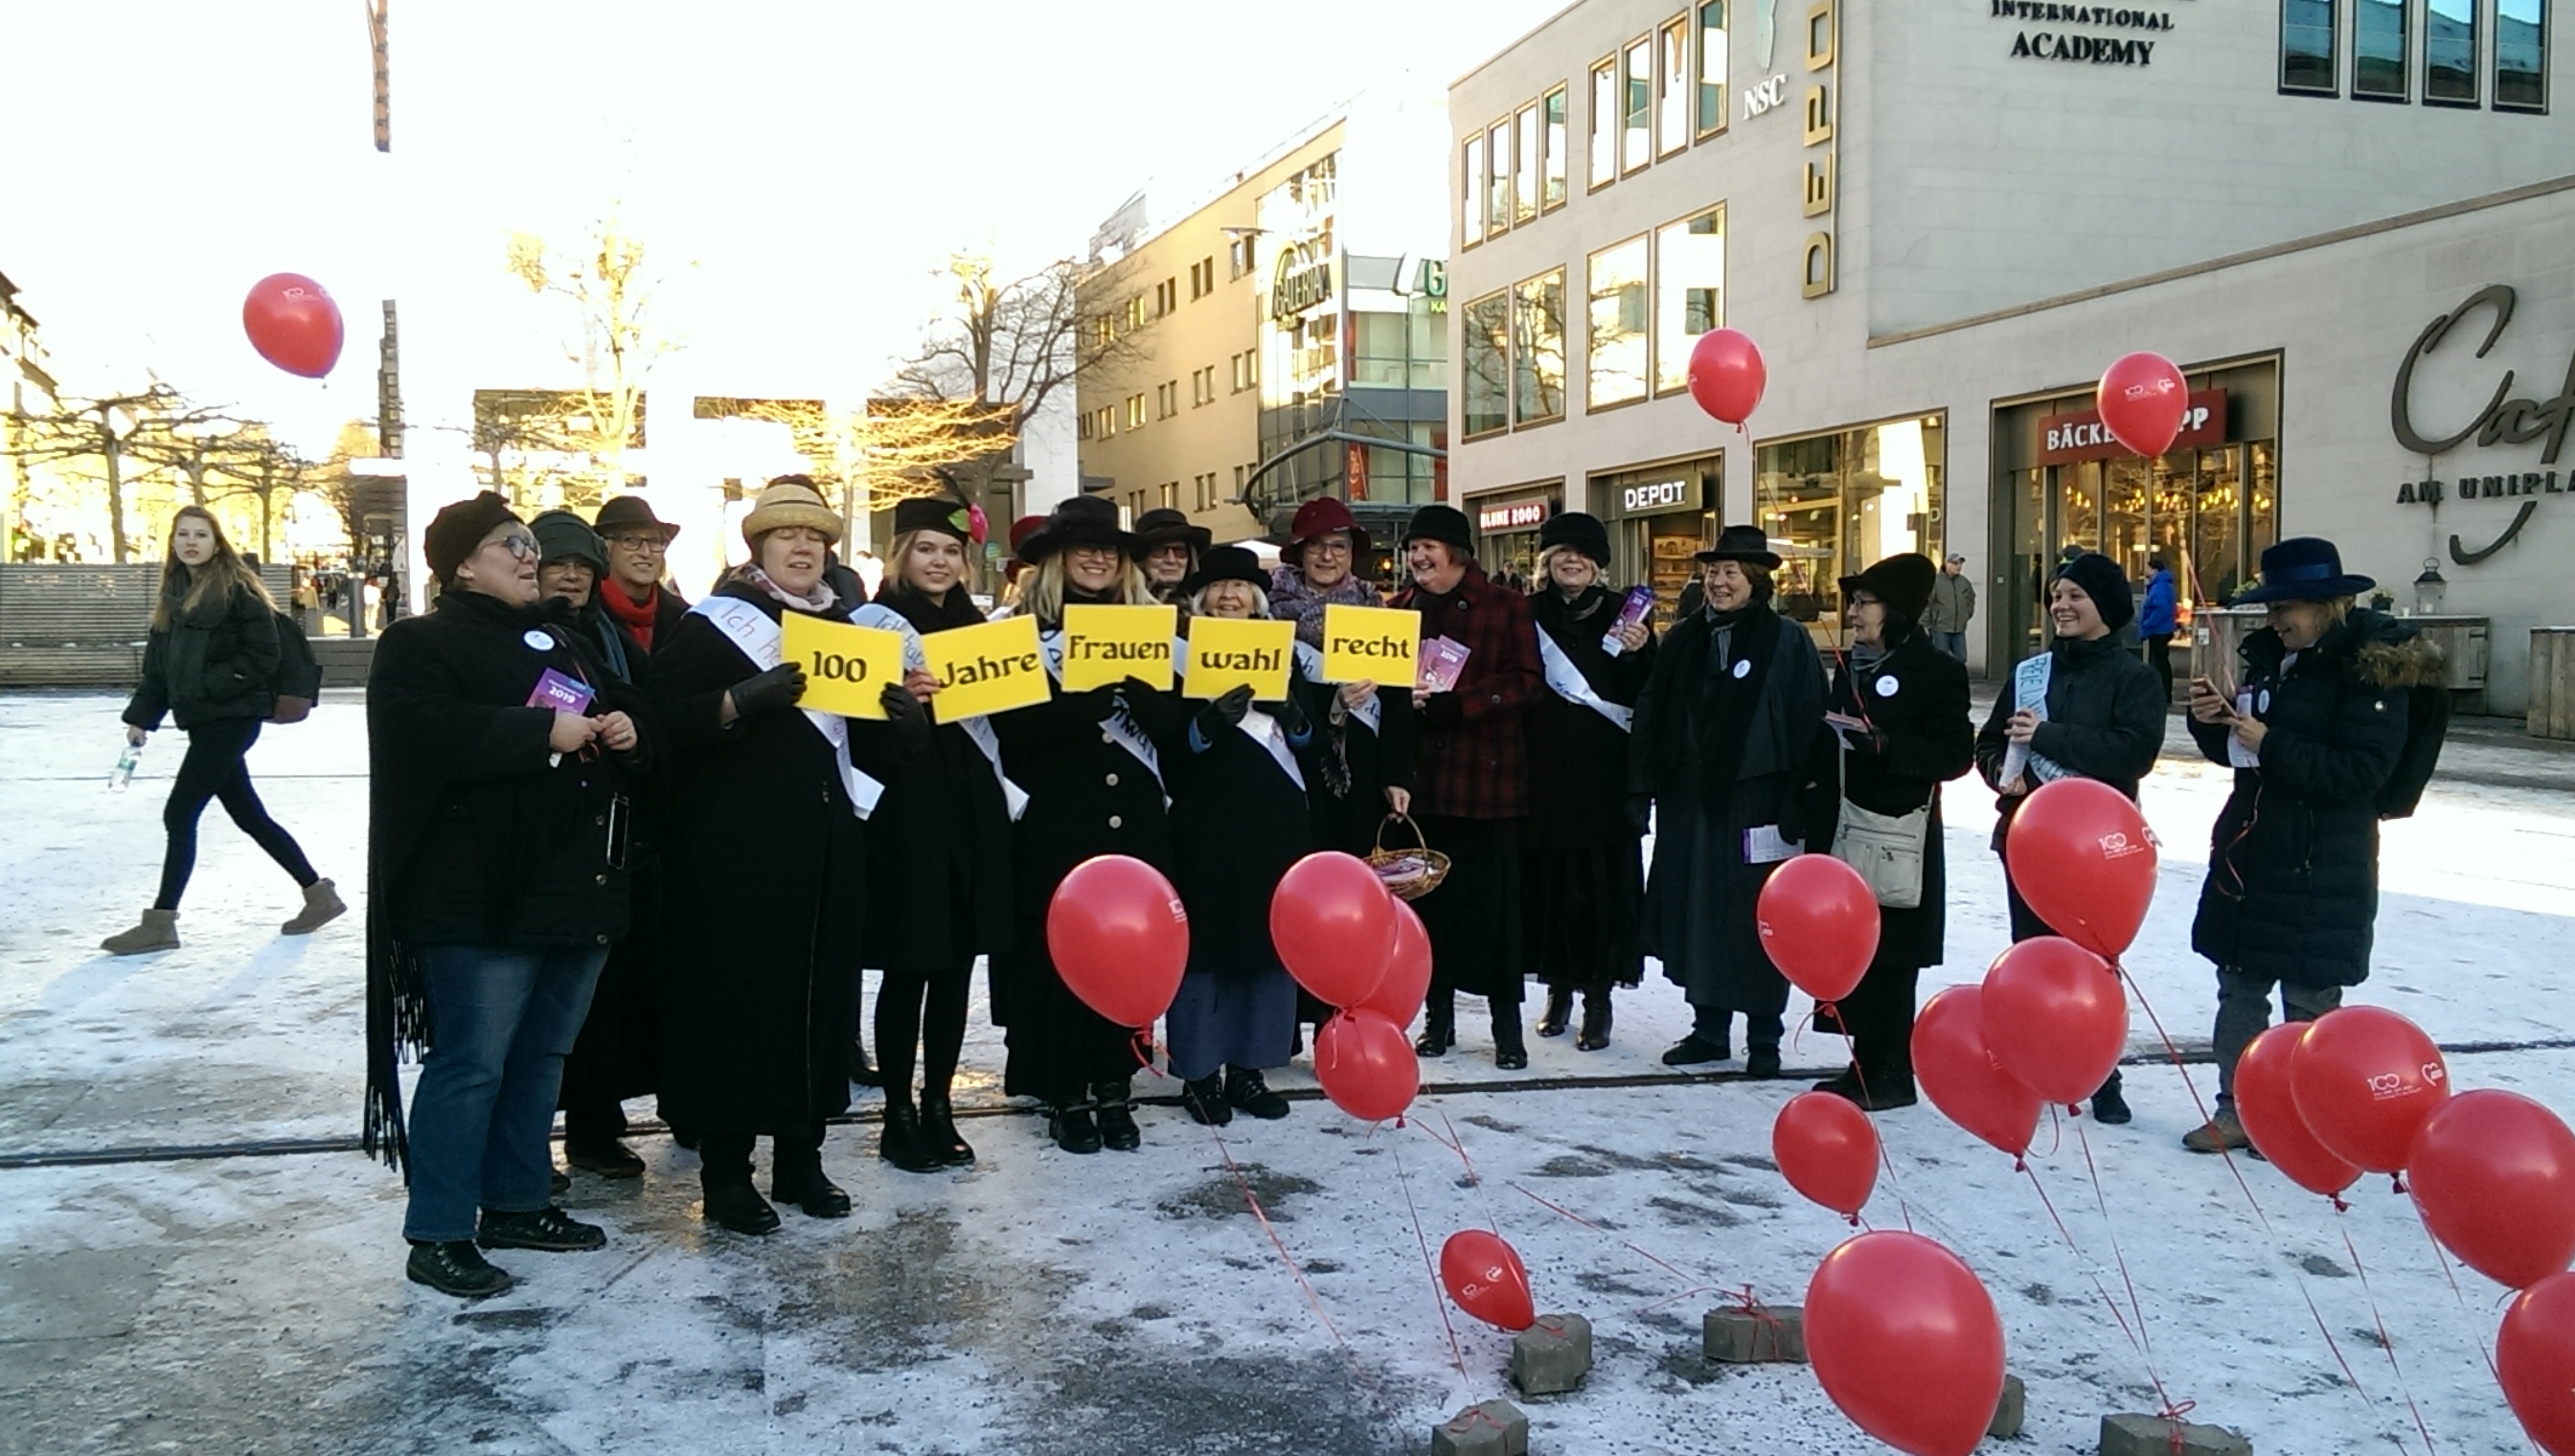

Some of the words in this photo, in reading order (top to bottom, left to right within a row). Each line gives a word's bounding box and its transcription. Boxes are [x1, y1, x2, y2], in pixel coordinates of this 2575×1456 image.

[1991, 0, 2176, 31] INTERNATIONAL
[2010, 31, 2155, 66] ACADEMY
[1743, 73, 1787, 121] NSC
[1625, 481, 1686, 509] DEPOT
[2397, 481, 2444, 504] AM
[1512, 505, 1540, 525] 2000
[719, 603, 756, 639] Ich
[1068, 634, 1170, 660] Frauen
[1200, 648, 1282, 671] wahl
[1333, 635, 1411, 659] recht
[812, 649, 867, 683] 100
[938, 652, 1039, 689] Jahre
[548, 685, 576, 704] 2019
[2366, 1072, 2401, 1093] 100
